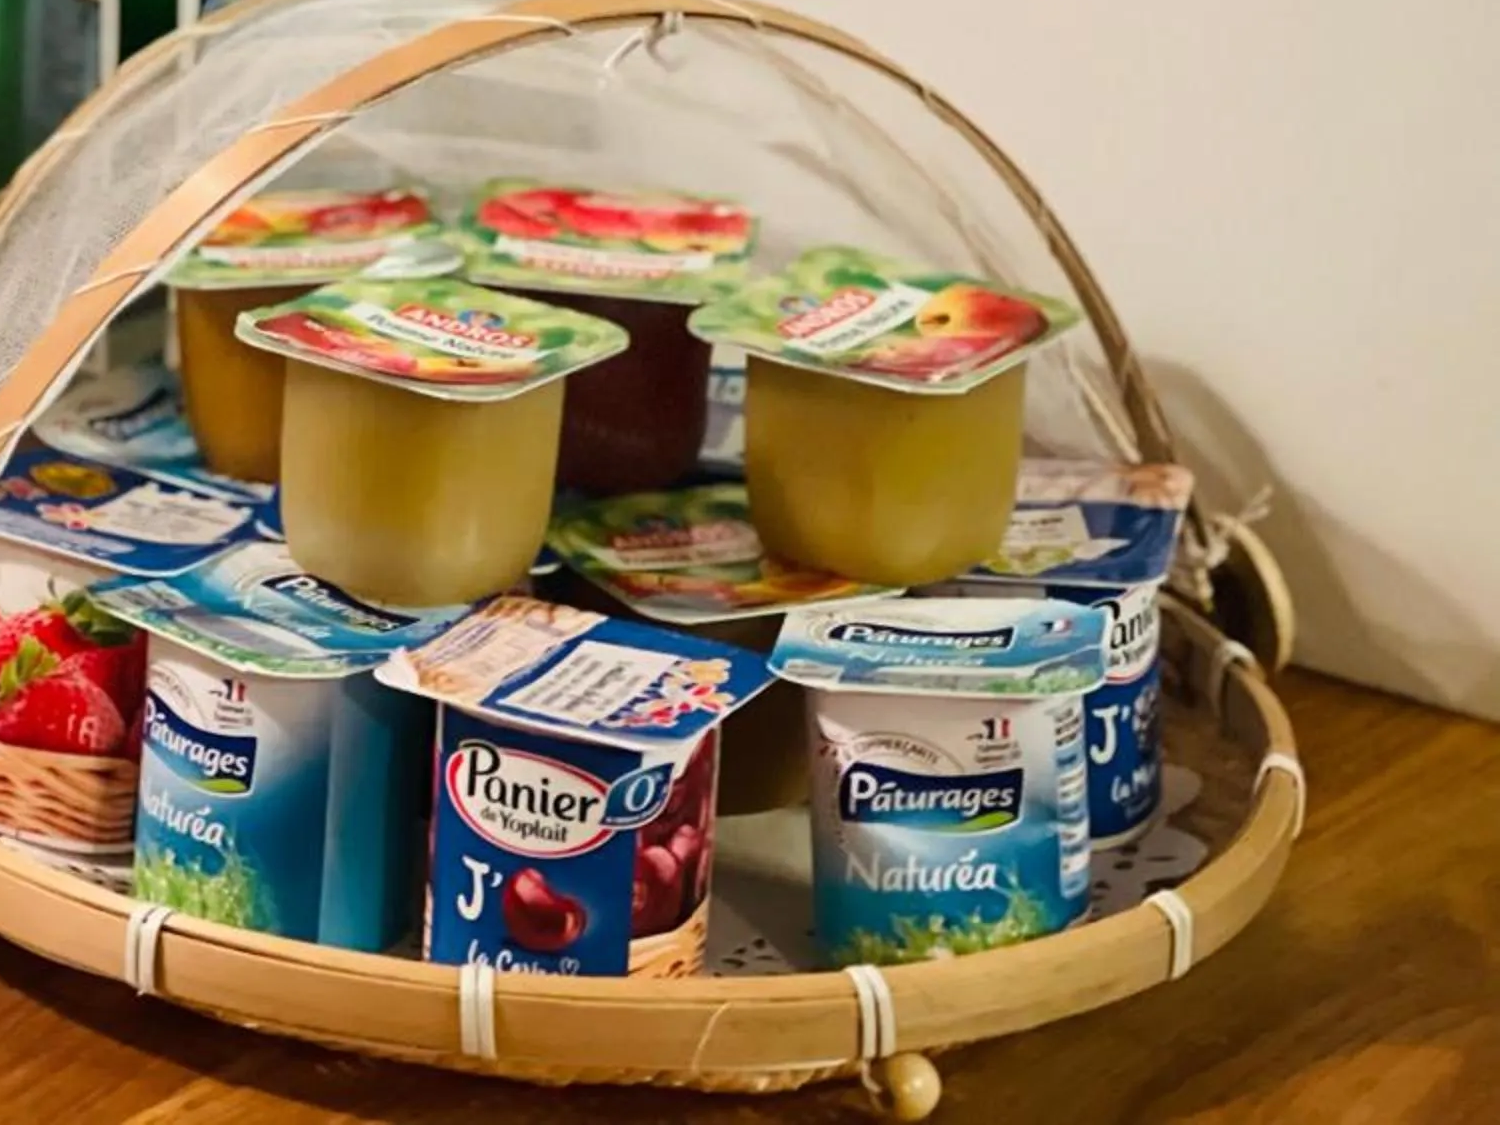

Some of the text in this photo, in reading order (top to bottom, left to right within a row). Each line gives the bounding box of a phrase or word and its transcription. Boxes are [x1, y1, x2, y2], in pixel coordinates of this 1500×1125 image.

[400, 307, 534, 349] ANDROS
[462, 742, 600, 823] Panier
[500, 809, 569, 843] Yoplait
[457, 854, 504, 921] J'
[845, 848, 999, 892] Naturéa
